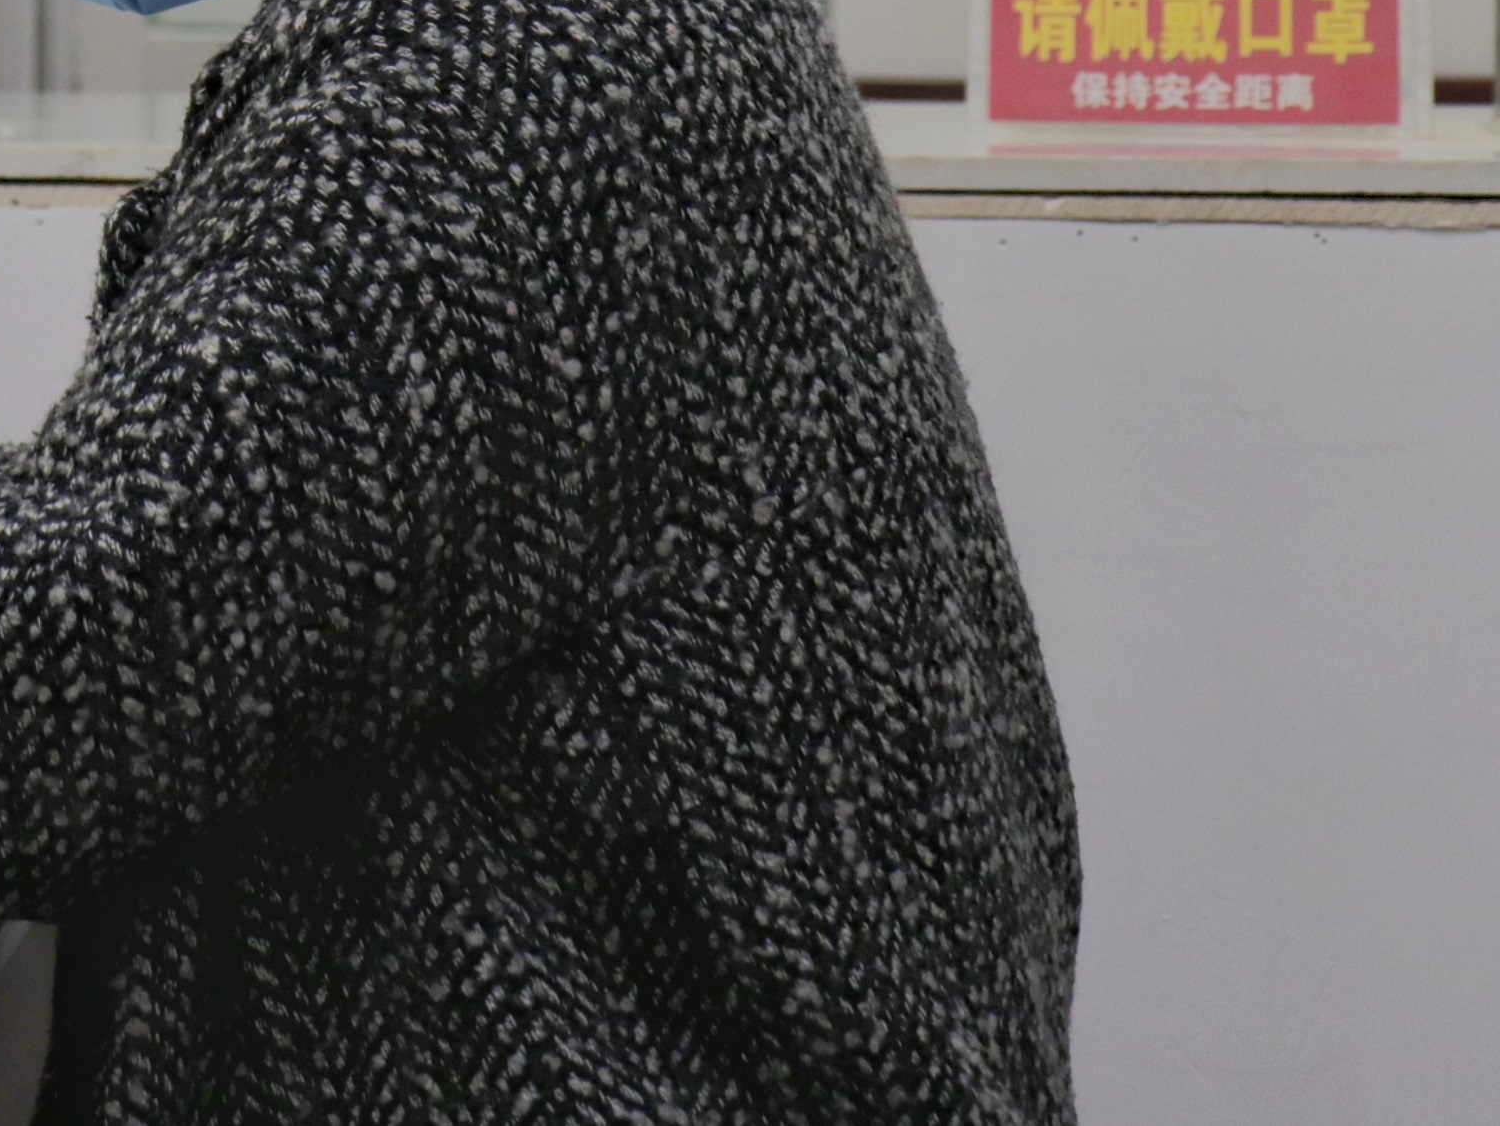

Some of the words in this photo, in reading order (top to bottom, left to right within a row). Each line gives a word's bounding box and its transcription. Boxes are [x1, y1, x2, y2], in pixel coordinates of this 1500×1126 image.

[1071, 70, 1315, 113] 保持安全距离
